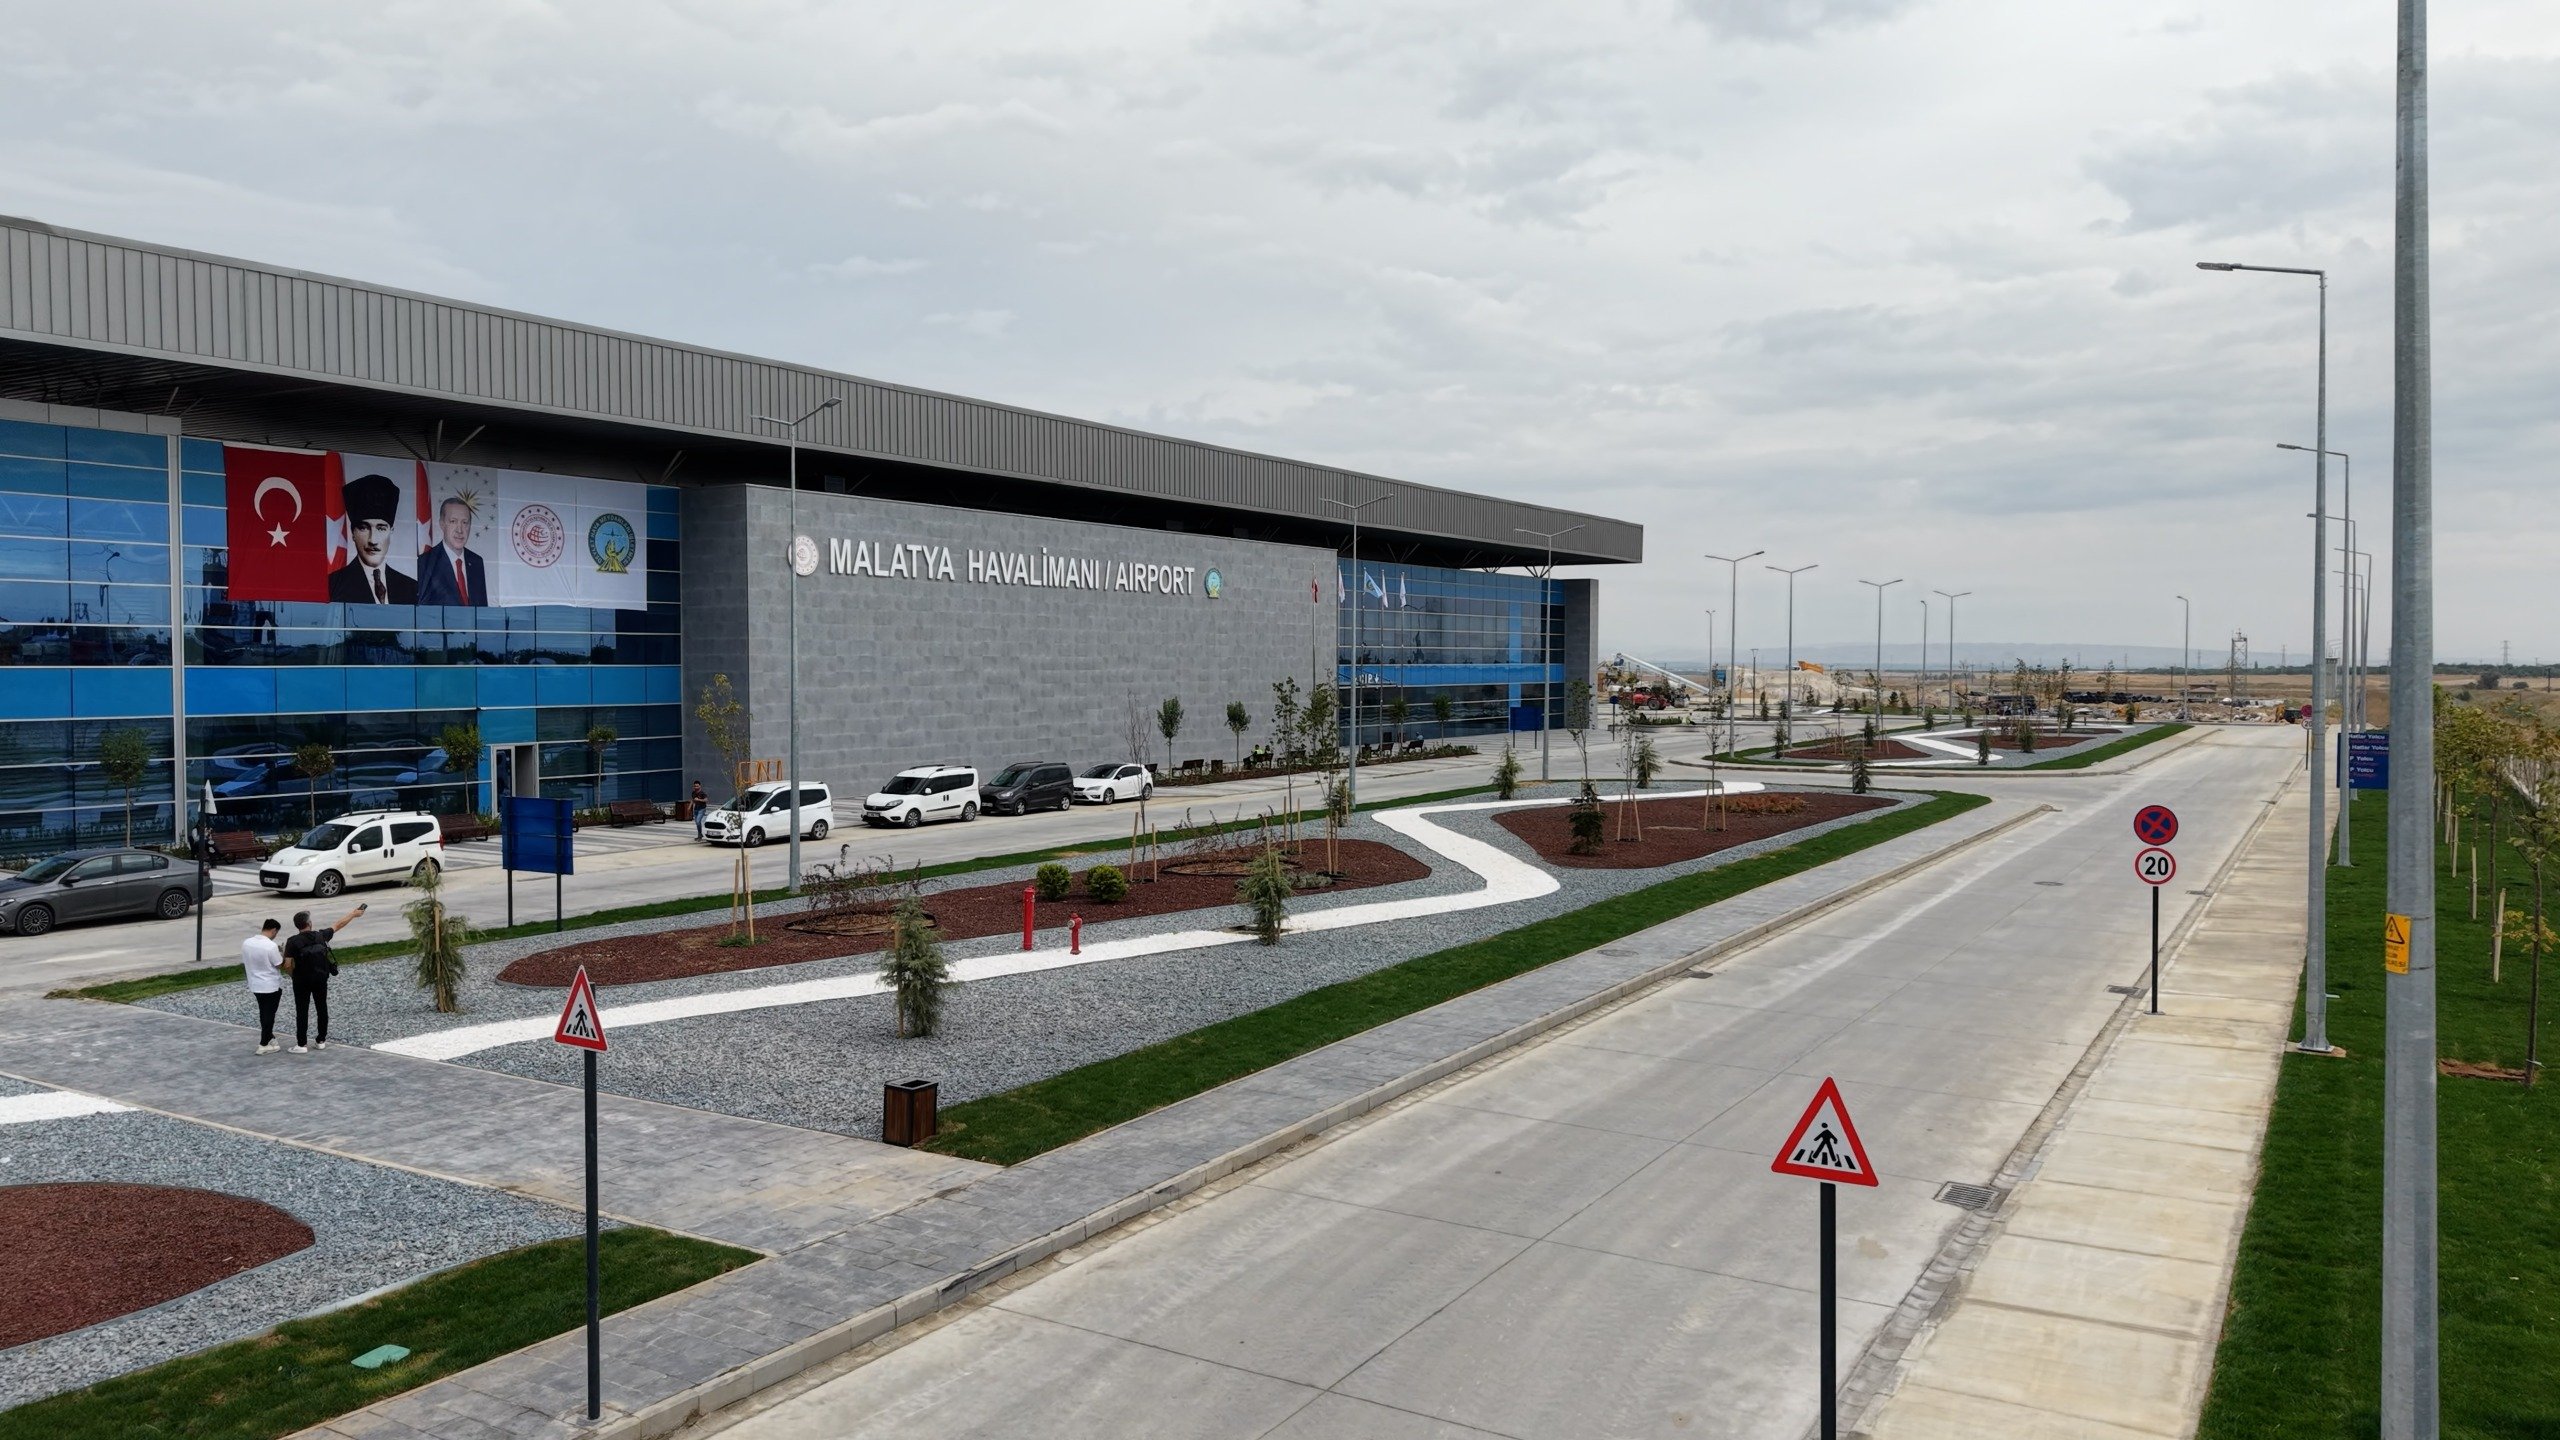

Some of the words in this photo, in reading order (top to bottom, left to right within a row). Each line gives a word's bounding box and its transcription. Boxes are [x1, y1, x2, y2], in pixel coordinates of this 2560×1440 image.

[830, 537, 955, 581] MALATYA
[968, 547, 1100, 589] HAVALİMANI
[1115, 561, 1195, 595] AIRPORT
[2145, 856, 2168, 875] 20
